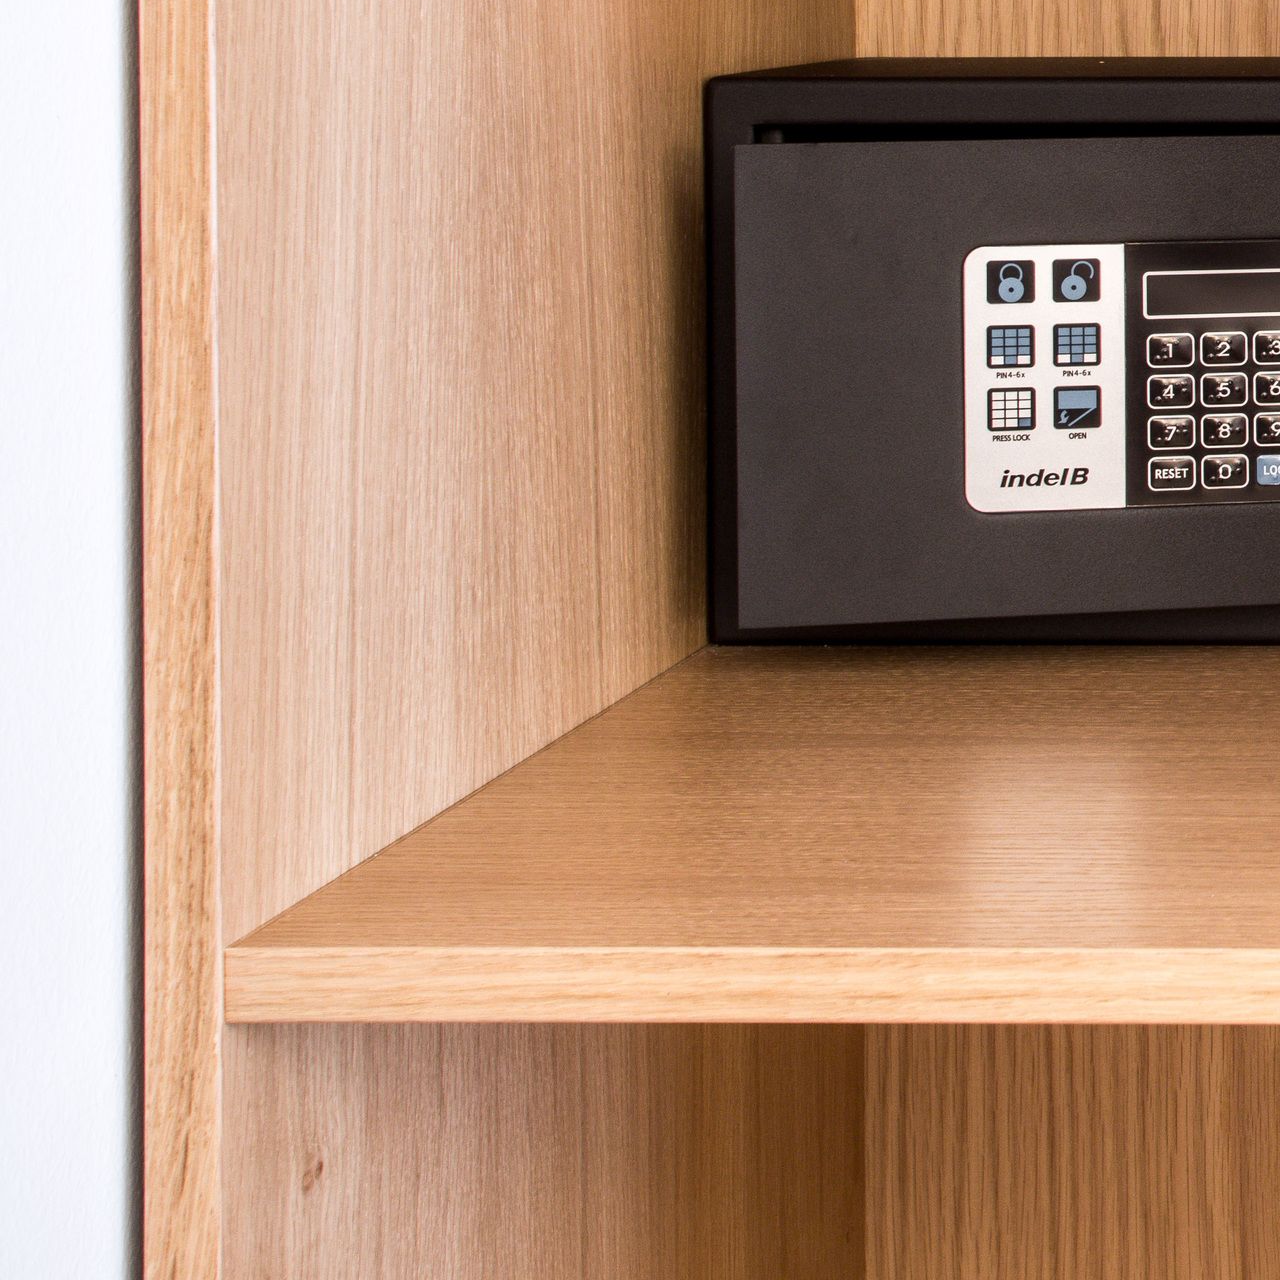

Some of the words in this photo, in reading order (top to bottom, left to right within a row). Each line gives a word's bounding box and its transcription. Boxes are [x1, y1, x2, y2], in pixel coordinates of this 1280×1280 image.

[1166, 343, 1174, 358] 1
[1219, 341, 1231, 357] 2
[1162, 384, 1175, 399] 4
[1219, 382, 1231, 398] 5
[992, 434, 1012, 442] PRESS
[1068, 432, 1087, 440] OPEN
[1165, 426, 1177, 441] 7
[1218, 423, 1231, 439] 8
[1154, 468, 1189, 480] RESET
